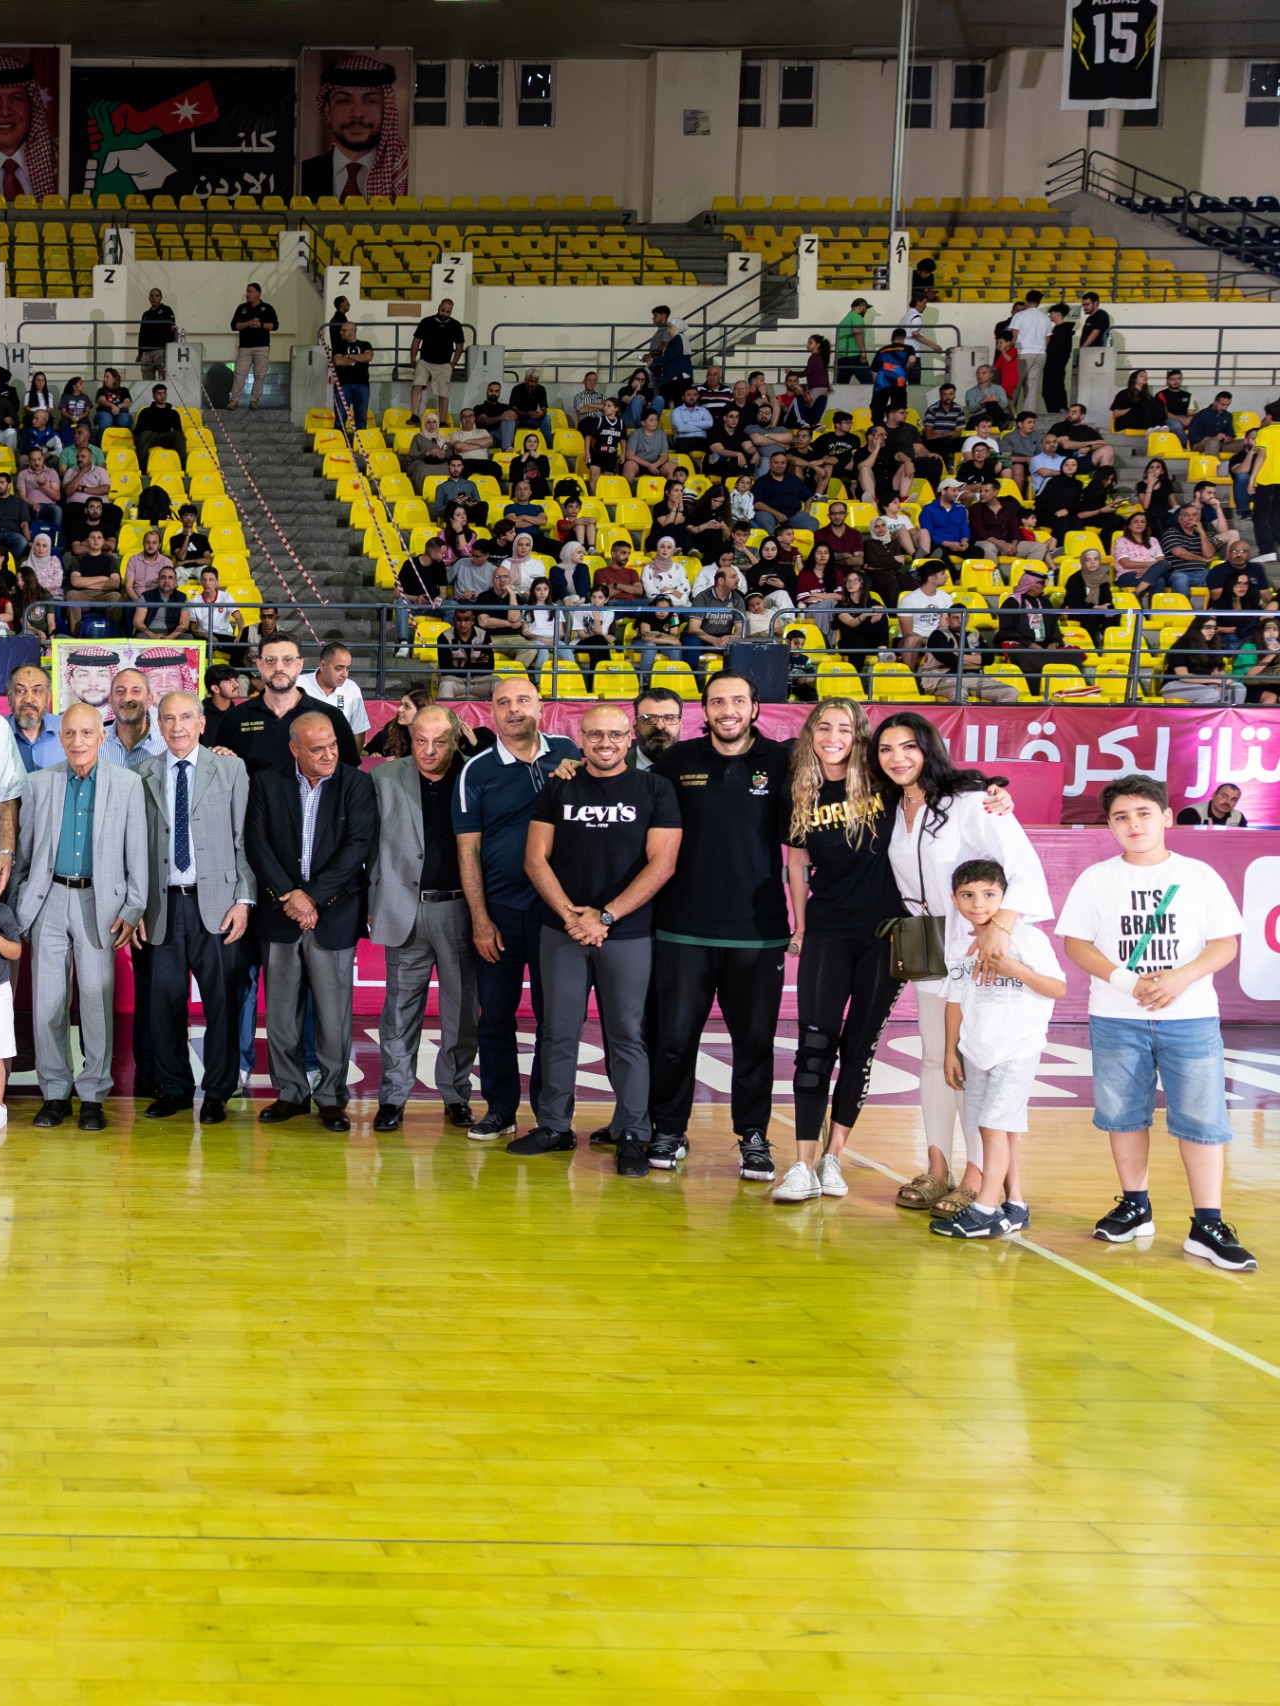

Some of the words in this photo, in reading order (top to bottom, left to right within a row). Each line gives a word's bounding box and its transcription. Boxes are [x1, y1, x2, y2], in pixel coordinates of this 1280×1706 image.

[1092, 12, 1138, 64] 15
[622, 213, 631, 226] Z
[805, 239, 816, 256] Z
[896, 237, 907, 251] A
[739, 258, 750, 272] Z
[104, 269, 115, 283] Z
[339, 272, 350, 286] Z
[444, 269, 454, 284] Z
[12, 348, 24, 363] H
[177, 348, 191, 362] H
[1095, 352, 1104, 367] J
[607, 435, 613, 445] 8
[1184, 725, 1280, 798] تاز
[809, 792, 885, 826] JORN
[1131, 889, 1163, 911] IT'S
[1120, 913, 1176, 936] BRAVE
